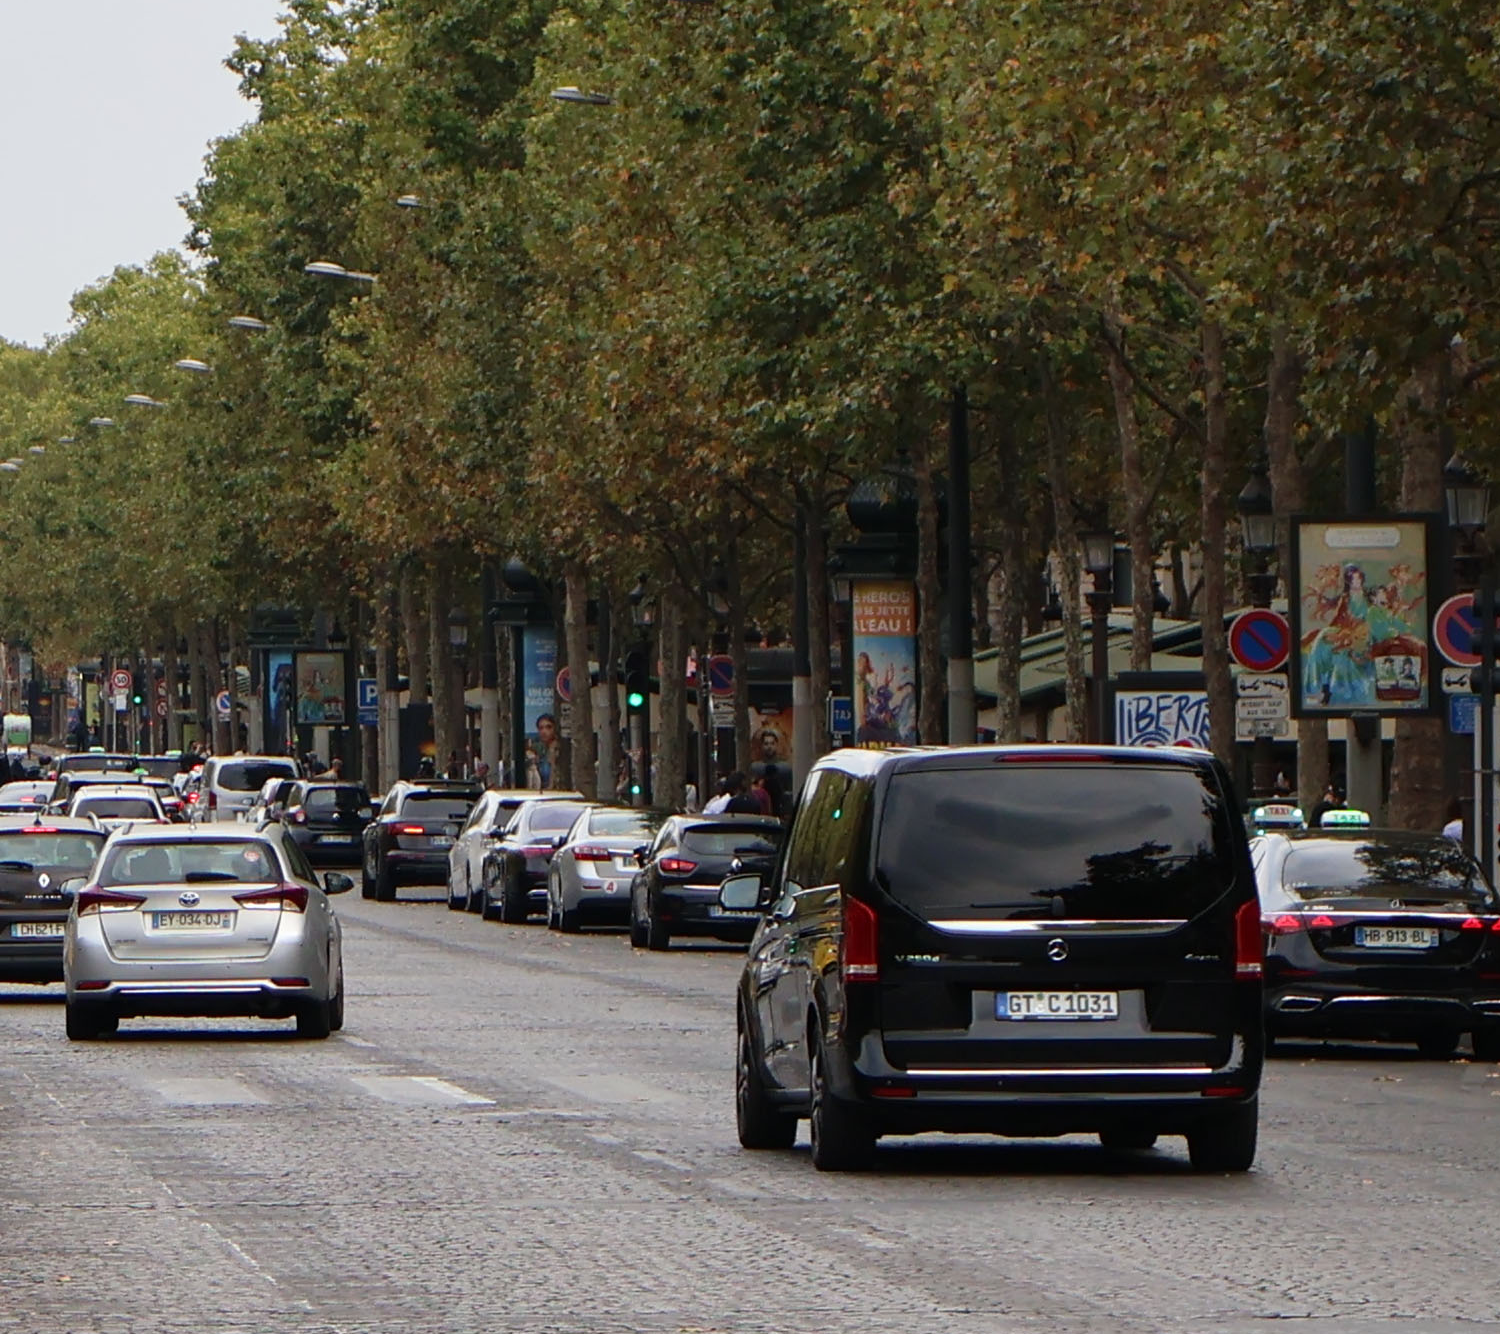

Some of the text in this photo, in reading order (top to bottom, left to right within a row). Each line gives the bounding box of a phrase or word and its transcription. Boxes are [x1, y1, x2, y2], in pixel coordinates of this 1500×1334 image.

[606, 881, 615, 892] 4
[1009, 995, 1114, 1013] GT C 1031
